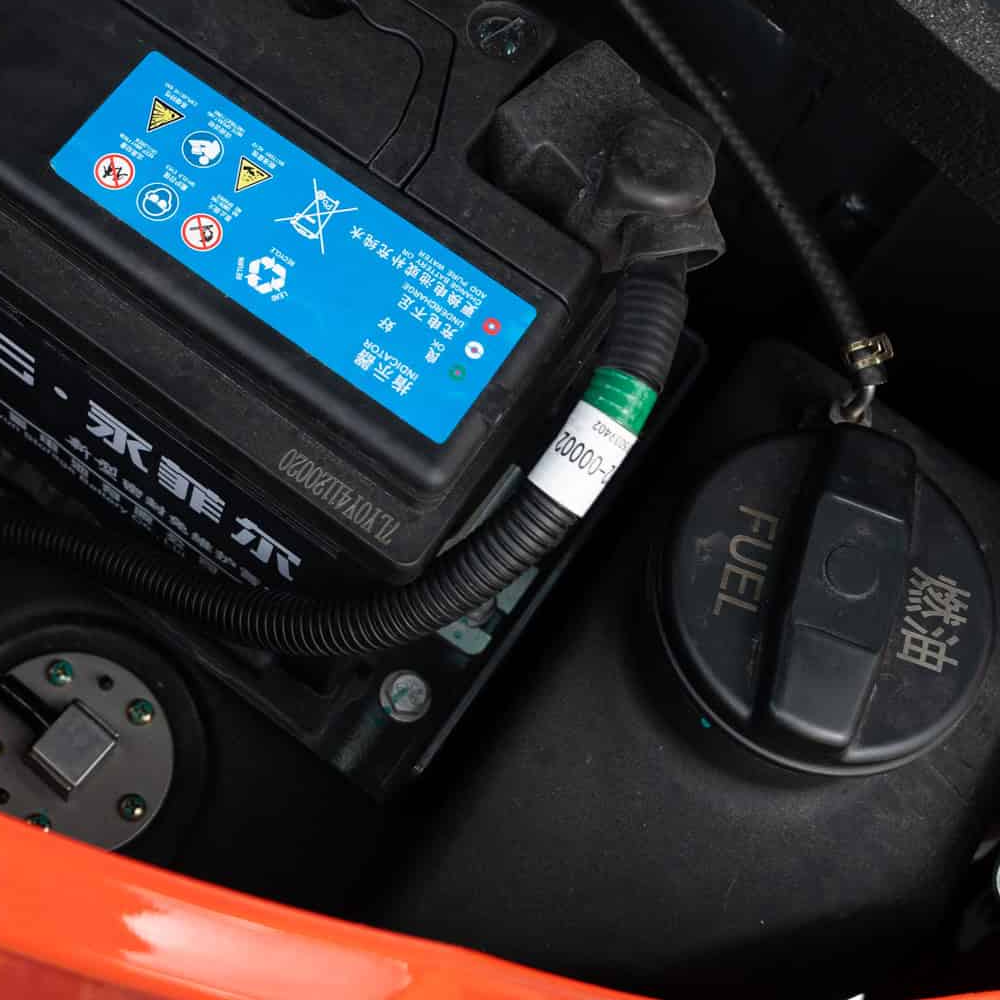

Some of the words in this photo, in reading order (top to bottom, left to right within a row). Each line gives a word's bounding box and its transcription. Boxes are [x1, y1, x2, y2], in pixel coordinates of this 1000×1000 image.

[350, 225, 478, 318] 更换电池或补充纯水
[416, 255, 450, 284] BATTERY
[418, 250, 444, 270] WATER
[402, 283, 465, 328] UNDERCHARGE
[450, 282, 482, 305] CHANGE
[470, 286, 487, 299] ADD
[397, 294, 458, 340] 充电不足
[363, 339, 419, 381] INDICATOR
[431, 339, 445, 352] OK
[354, 349, 413, 396] 指示器
[712, 504, 778, 616] FUEL
[895, 564, 972, 674] 燃油
